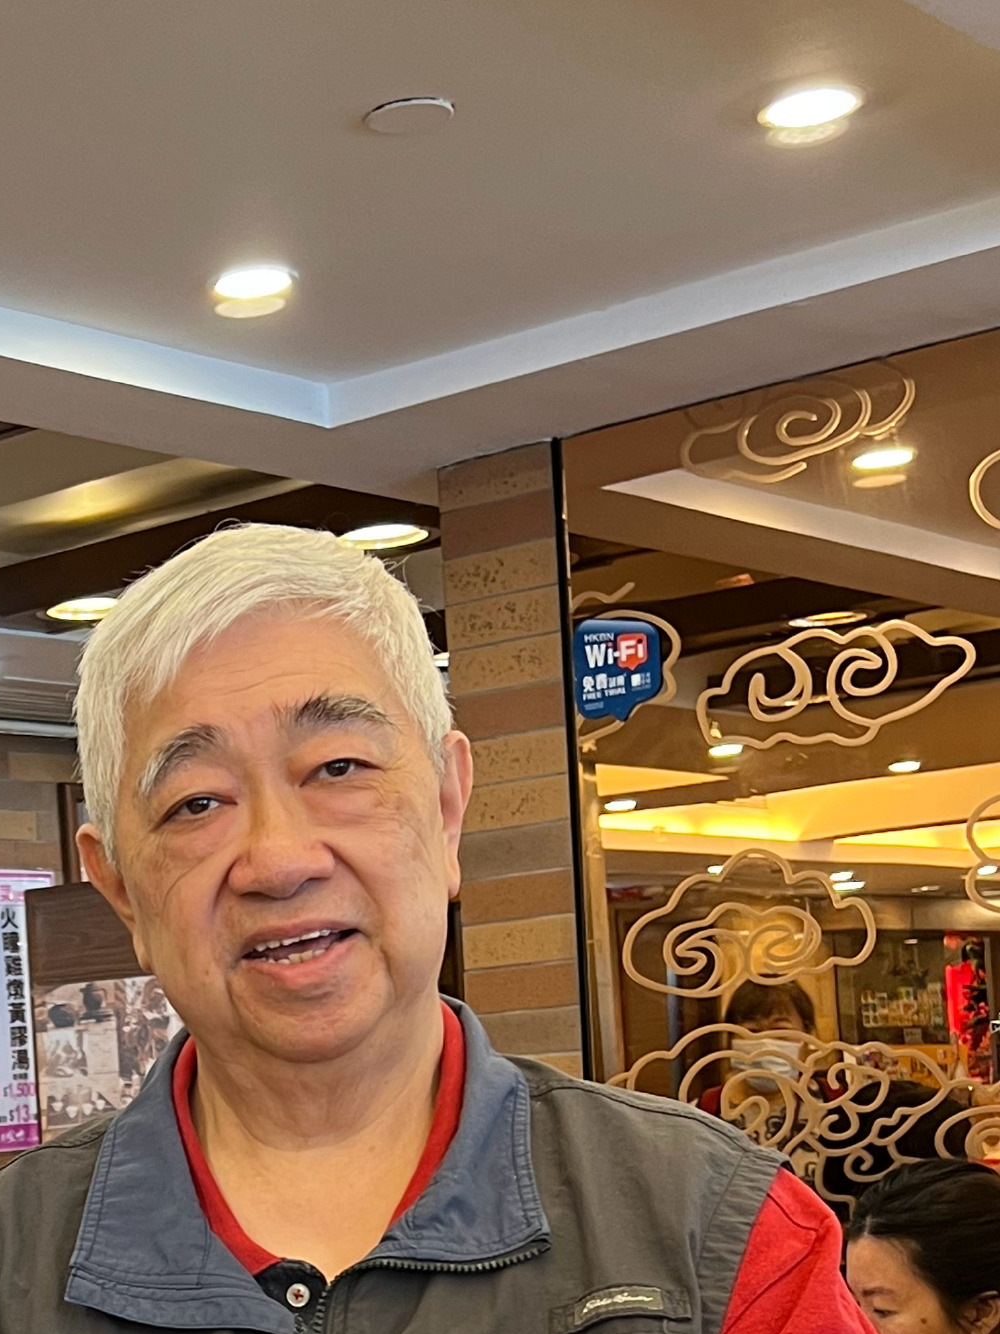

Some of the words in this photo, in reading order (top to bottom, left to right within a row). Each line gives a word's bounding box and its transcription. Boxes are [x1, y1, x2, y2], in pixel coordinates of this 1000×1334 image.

[584, 632, 615, 643] HKBN
[585, 638, 645, 669] Wi-Fi
[583, 691, 603, 701] FREE
